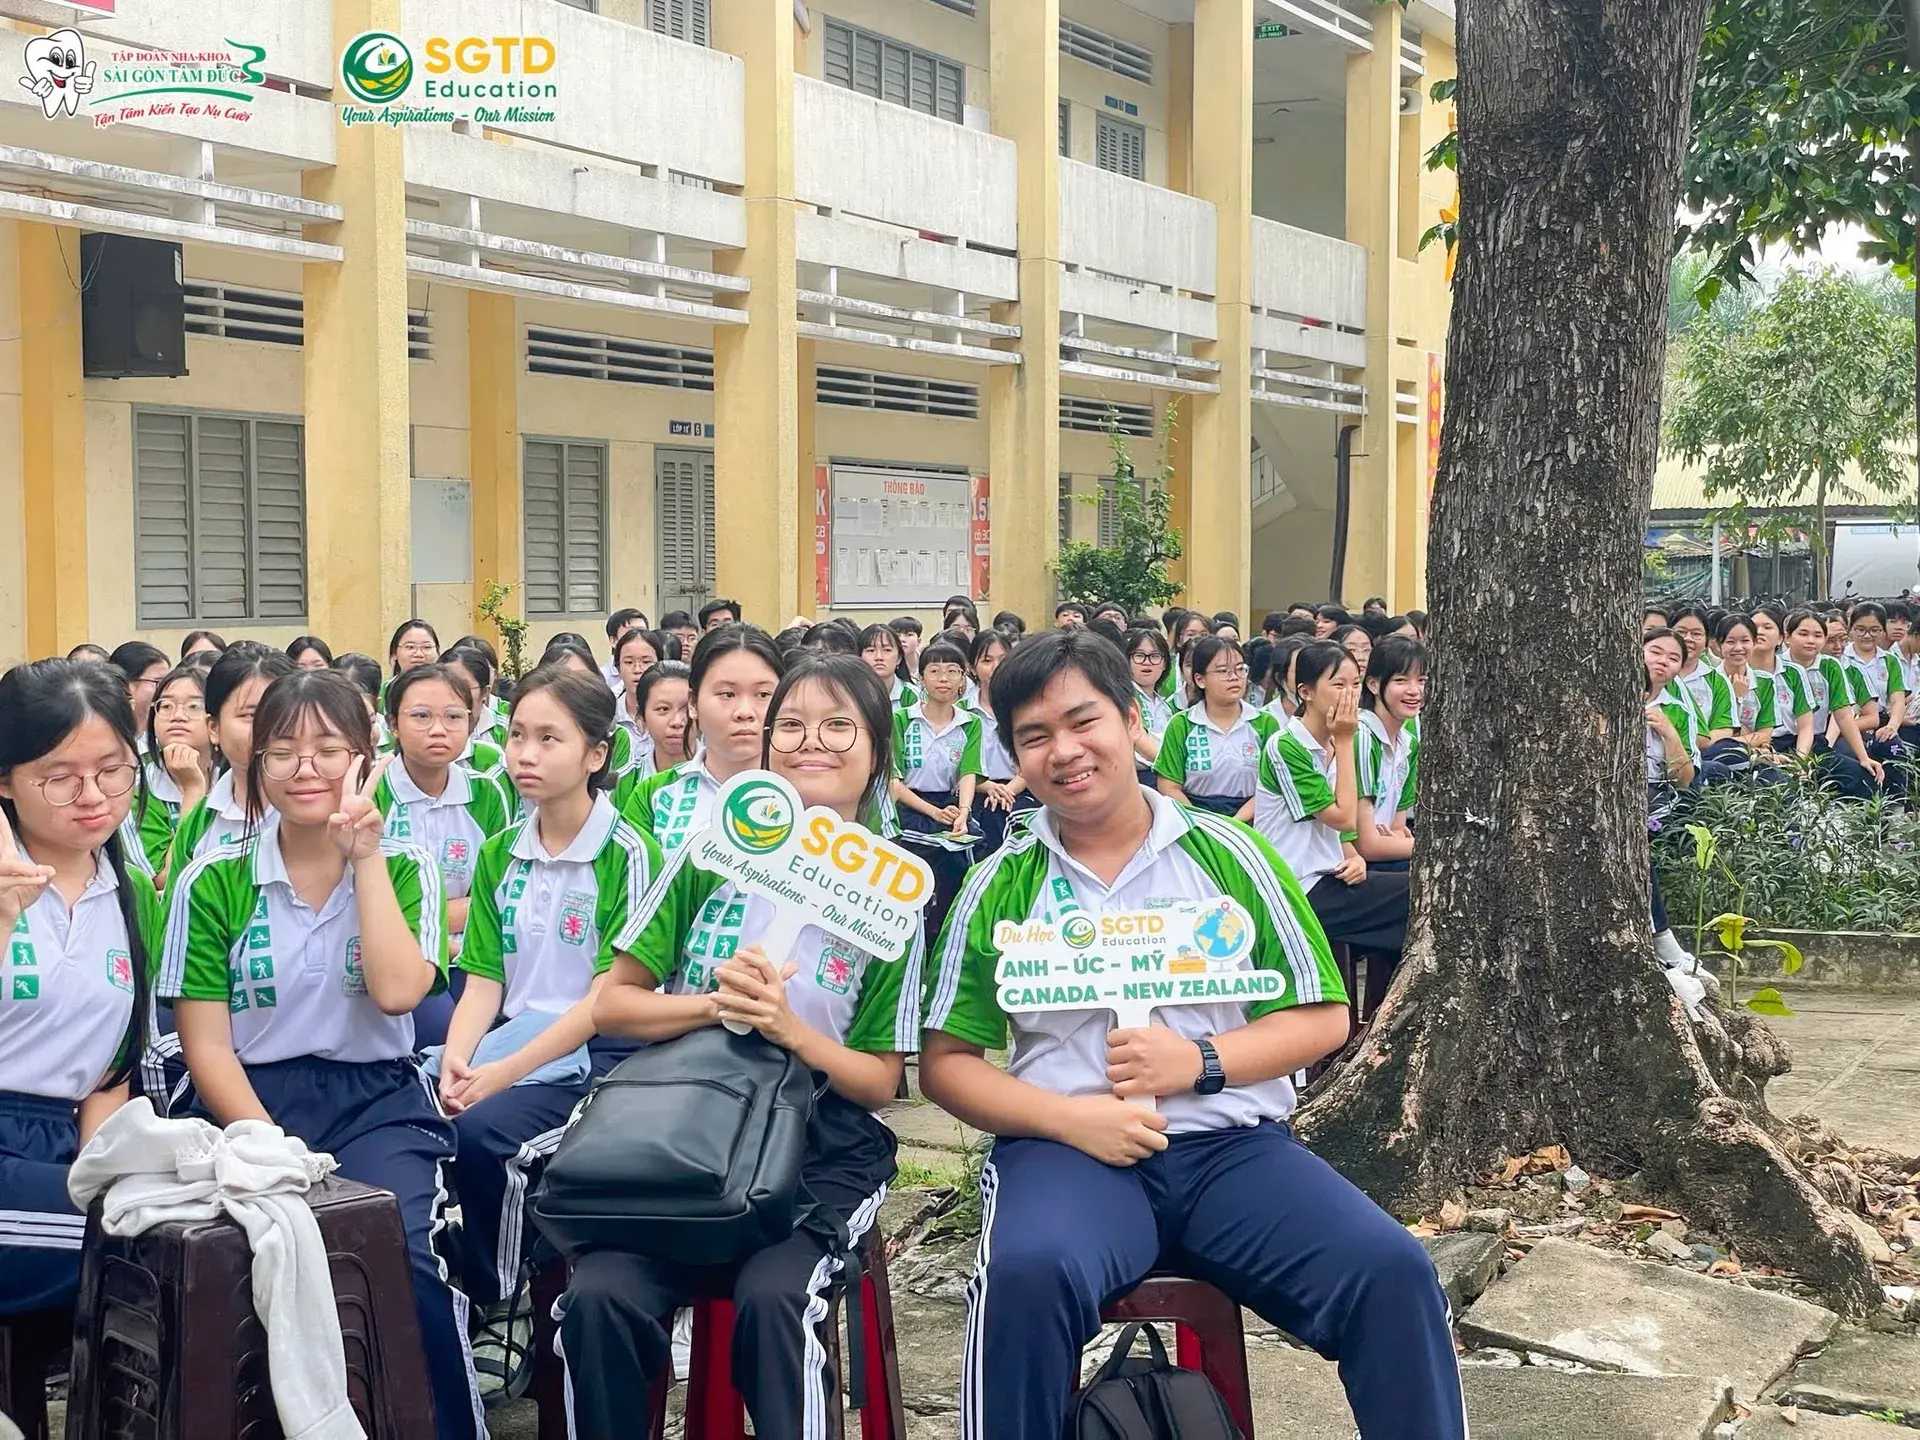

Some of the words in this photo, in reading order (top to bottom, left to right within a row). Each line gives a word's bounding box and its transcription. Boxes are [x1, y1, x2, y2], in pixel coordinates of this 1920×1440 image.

[883, 480, 908, 494] THÔNG
[909, 481, 925, 496] BÁO
[801, 816, 925, 902] SGTD
[701, 840, 734, 867] Your
[734, 860, 806, 906] Aspirations
[822, 904, 847, 926] Our
[848, 918, 895, 952] Mission
[788, 855, 908, 930] Education
[1000, 926, 1023, 945] Du
[1026, 924, 1056, 946] Học
[1101, 915, 1164, 935] SGTD
[1102, 936, 1167, 947] Education
[1002, 959, 1048, 978] ANH
[1073, 953, 1105, 975] ÚC
[1131, 949, 1165, 972] MỸ
[1004, 985, 1099, 1006] CANADA
[1123, 981, 1174, 1000] NEW
[1180, 976, 1279, 997] ZEALAND
